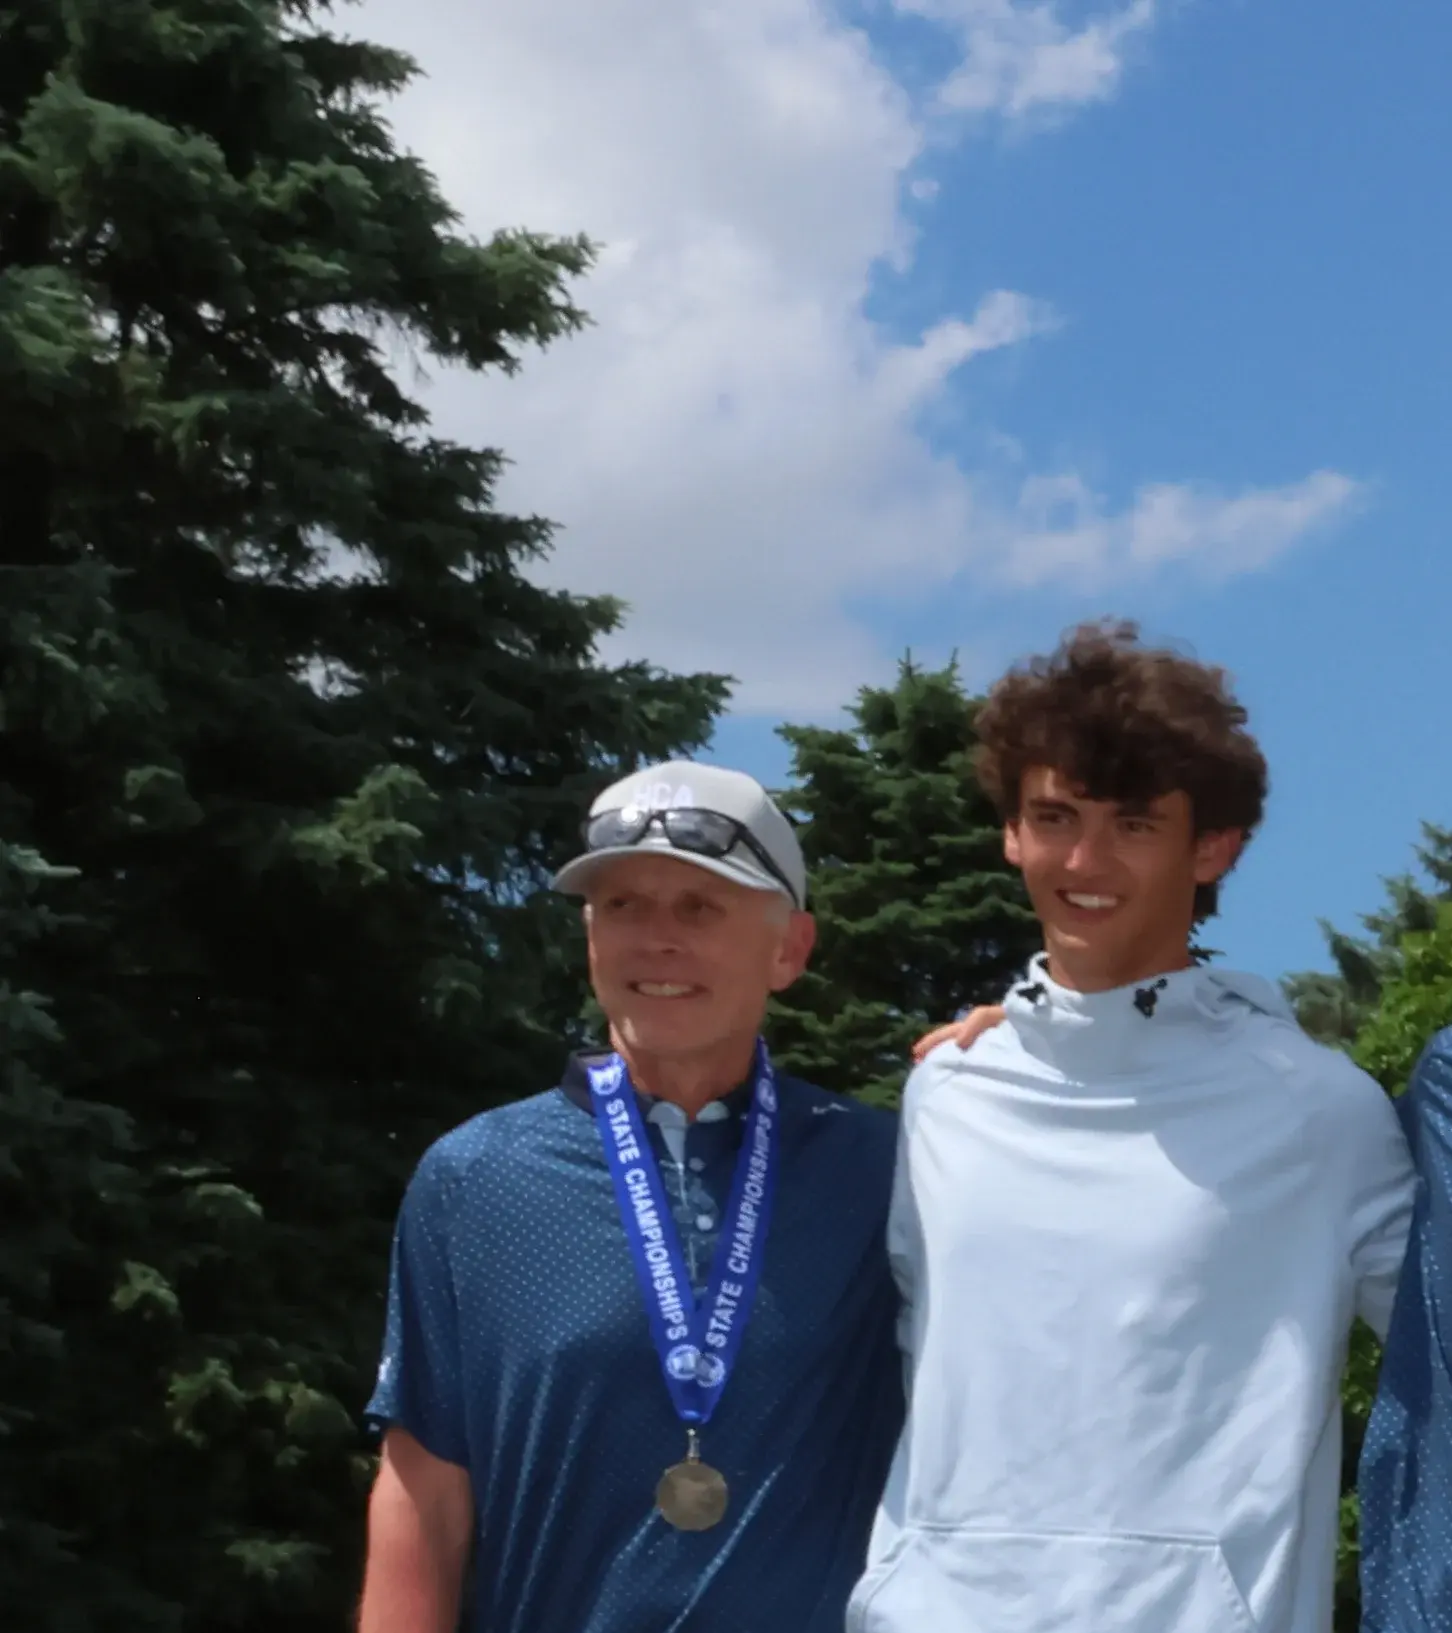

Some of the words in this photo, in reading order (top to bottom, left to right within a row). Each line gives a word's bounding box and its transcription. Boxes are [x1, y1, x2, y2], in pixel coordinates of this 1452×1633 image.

[633, 782, 694, 812] HCA
[606, 1098, 641, 1164] STATE
[624, 1167, 688, 1342] CHAMPIONSHIPS
[705, 1280, 743, 1349] STATE
[726, 1113, 773, 1275] CHAMPIONSHIPS
